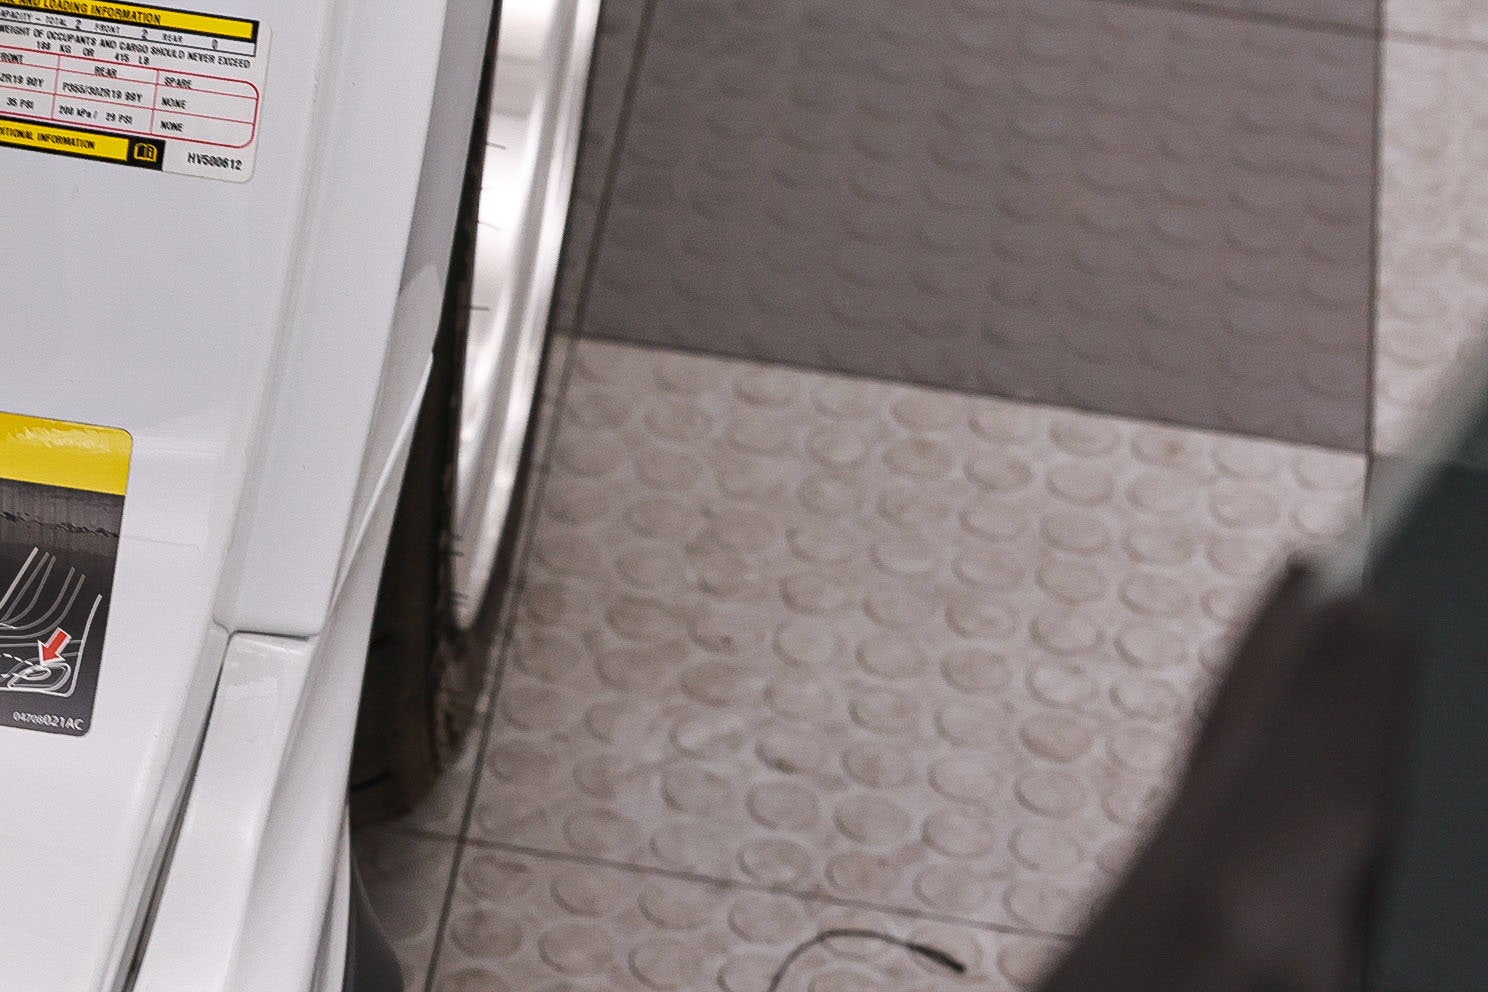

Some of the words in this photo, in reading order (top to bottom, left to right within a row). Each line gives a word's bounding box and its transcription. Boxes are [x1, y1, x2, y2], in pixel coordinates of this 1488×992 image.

[91, 3, 161, 25] INFORMATION
[75, 19, 82, 30] 2
[141, 29, 149, 40] 2
[33, 28, 44, 38] OF
[100, 38, 117, 49] AND
[119, 41, 149, 54] CARGO
[187, 52, 215, 64] NEVER
[95, 65, 118, 78] REAR
[164, 76, 193, 90] SPARE
[161, 96, 187, 110] NONE
[160, 120, 184, 133] NONE
[37, 132, 96, 150] INFORMATION
